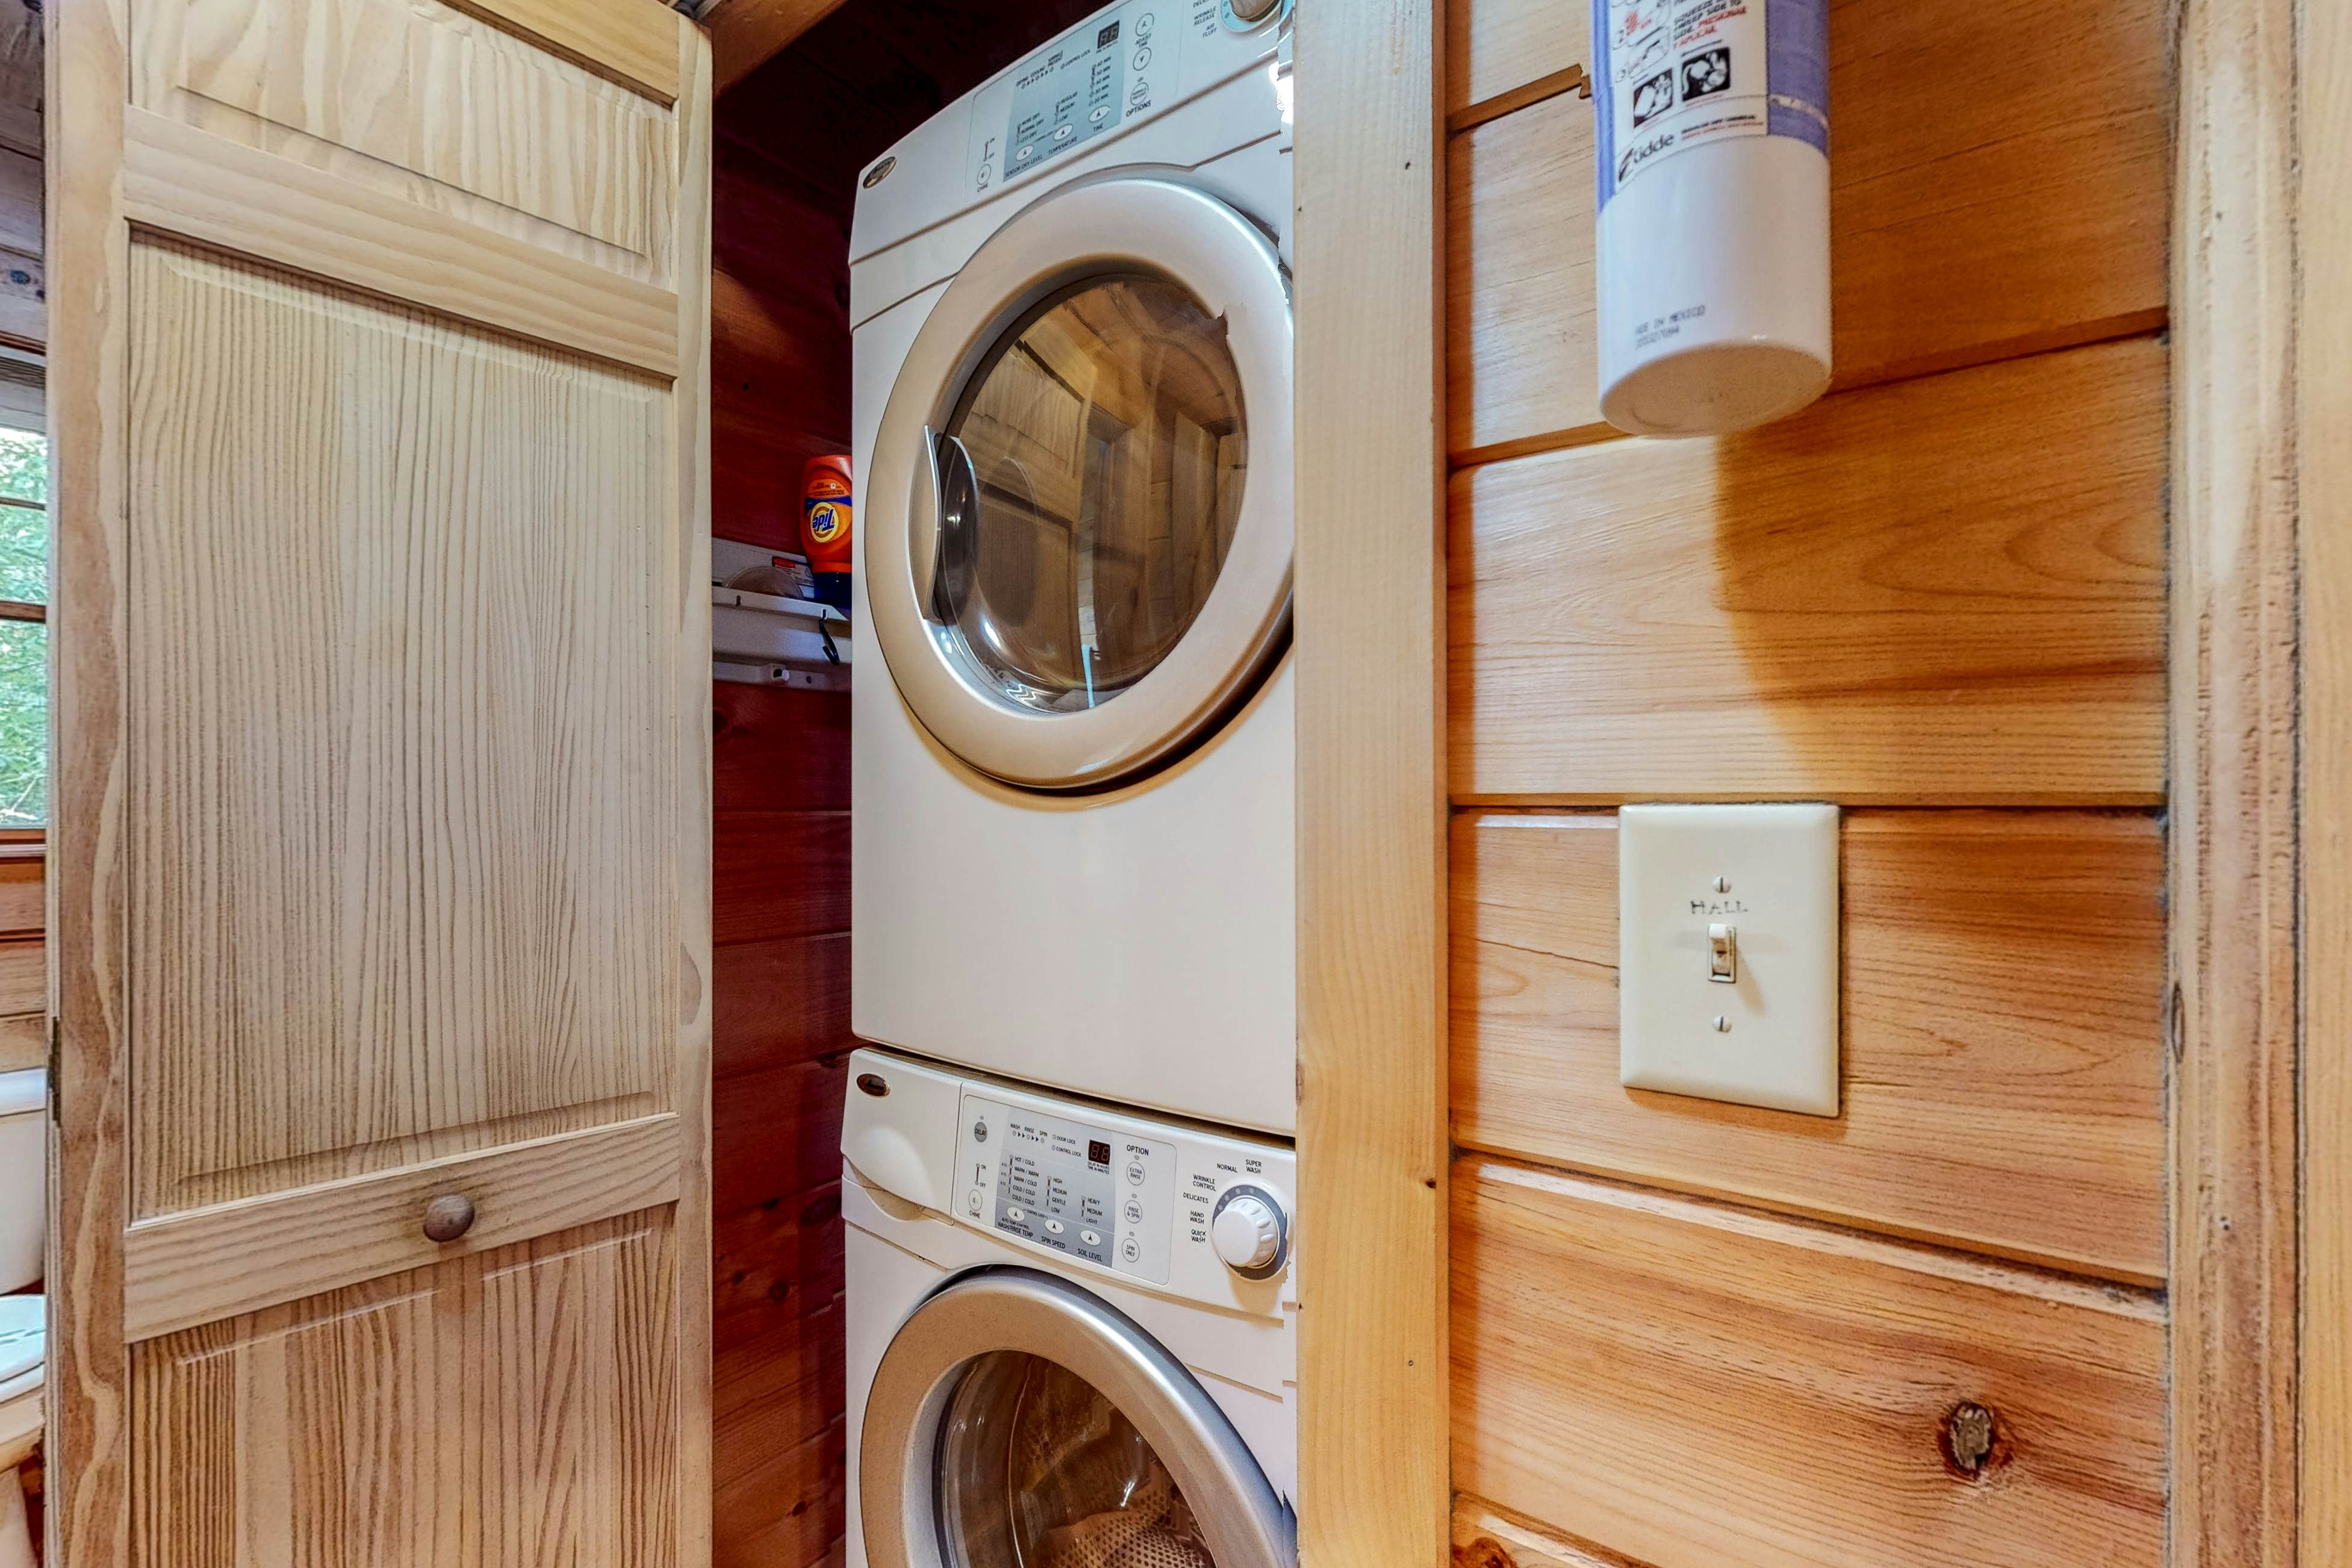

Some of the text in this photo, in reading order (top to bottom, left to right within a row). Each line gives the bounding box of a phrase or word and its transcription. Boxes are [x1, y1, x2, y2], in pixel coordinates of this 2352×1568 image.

[1126, 100, 1152, 117] OPTIONS
[812, 508, 835, 533] Tide
[1691, 900, 1748, 915] HALL
[975, 1127, 987, 1136] DELAY
[1056, 1146, 1071, 1155] CONTROL
[1127, 1144, 1149, 1156] OPTION
[1217, 1163, 1238, 1174] NORMAL
[1245, 1159, 1262, 1168] SUPER
[1246, 1166, 1261, 1174] WASH
[1193, 1174, 1216, 1185] WRINKLE
[1053, 1187, 1067, 1195] MEDIUM
[1193, 1181, 1217, 1192] CONTROL
[1052, 1197, 1066, 1206] GENTLE
[1087, 1197, 1100, 1206] HEAVY
[1183, 1192, 1209, 1204] DELICATES
[969, 1210, 981, 1219] CHIME
[1087, 1207, 1103, 1216] MEDIUM
[1022, 1229, 1033, 1238] TEMP
[1041, 1236, 1065, 1249] SPIN SPEED
[1078, 1248, 1103, 1262] SOIL LEVEL
